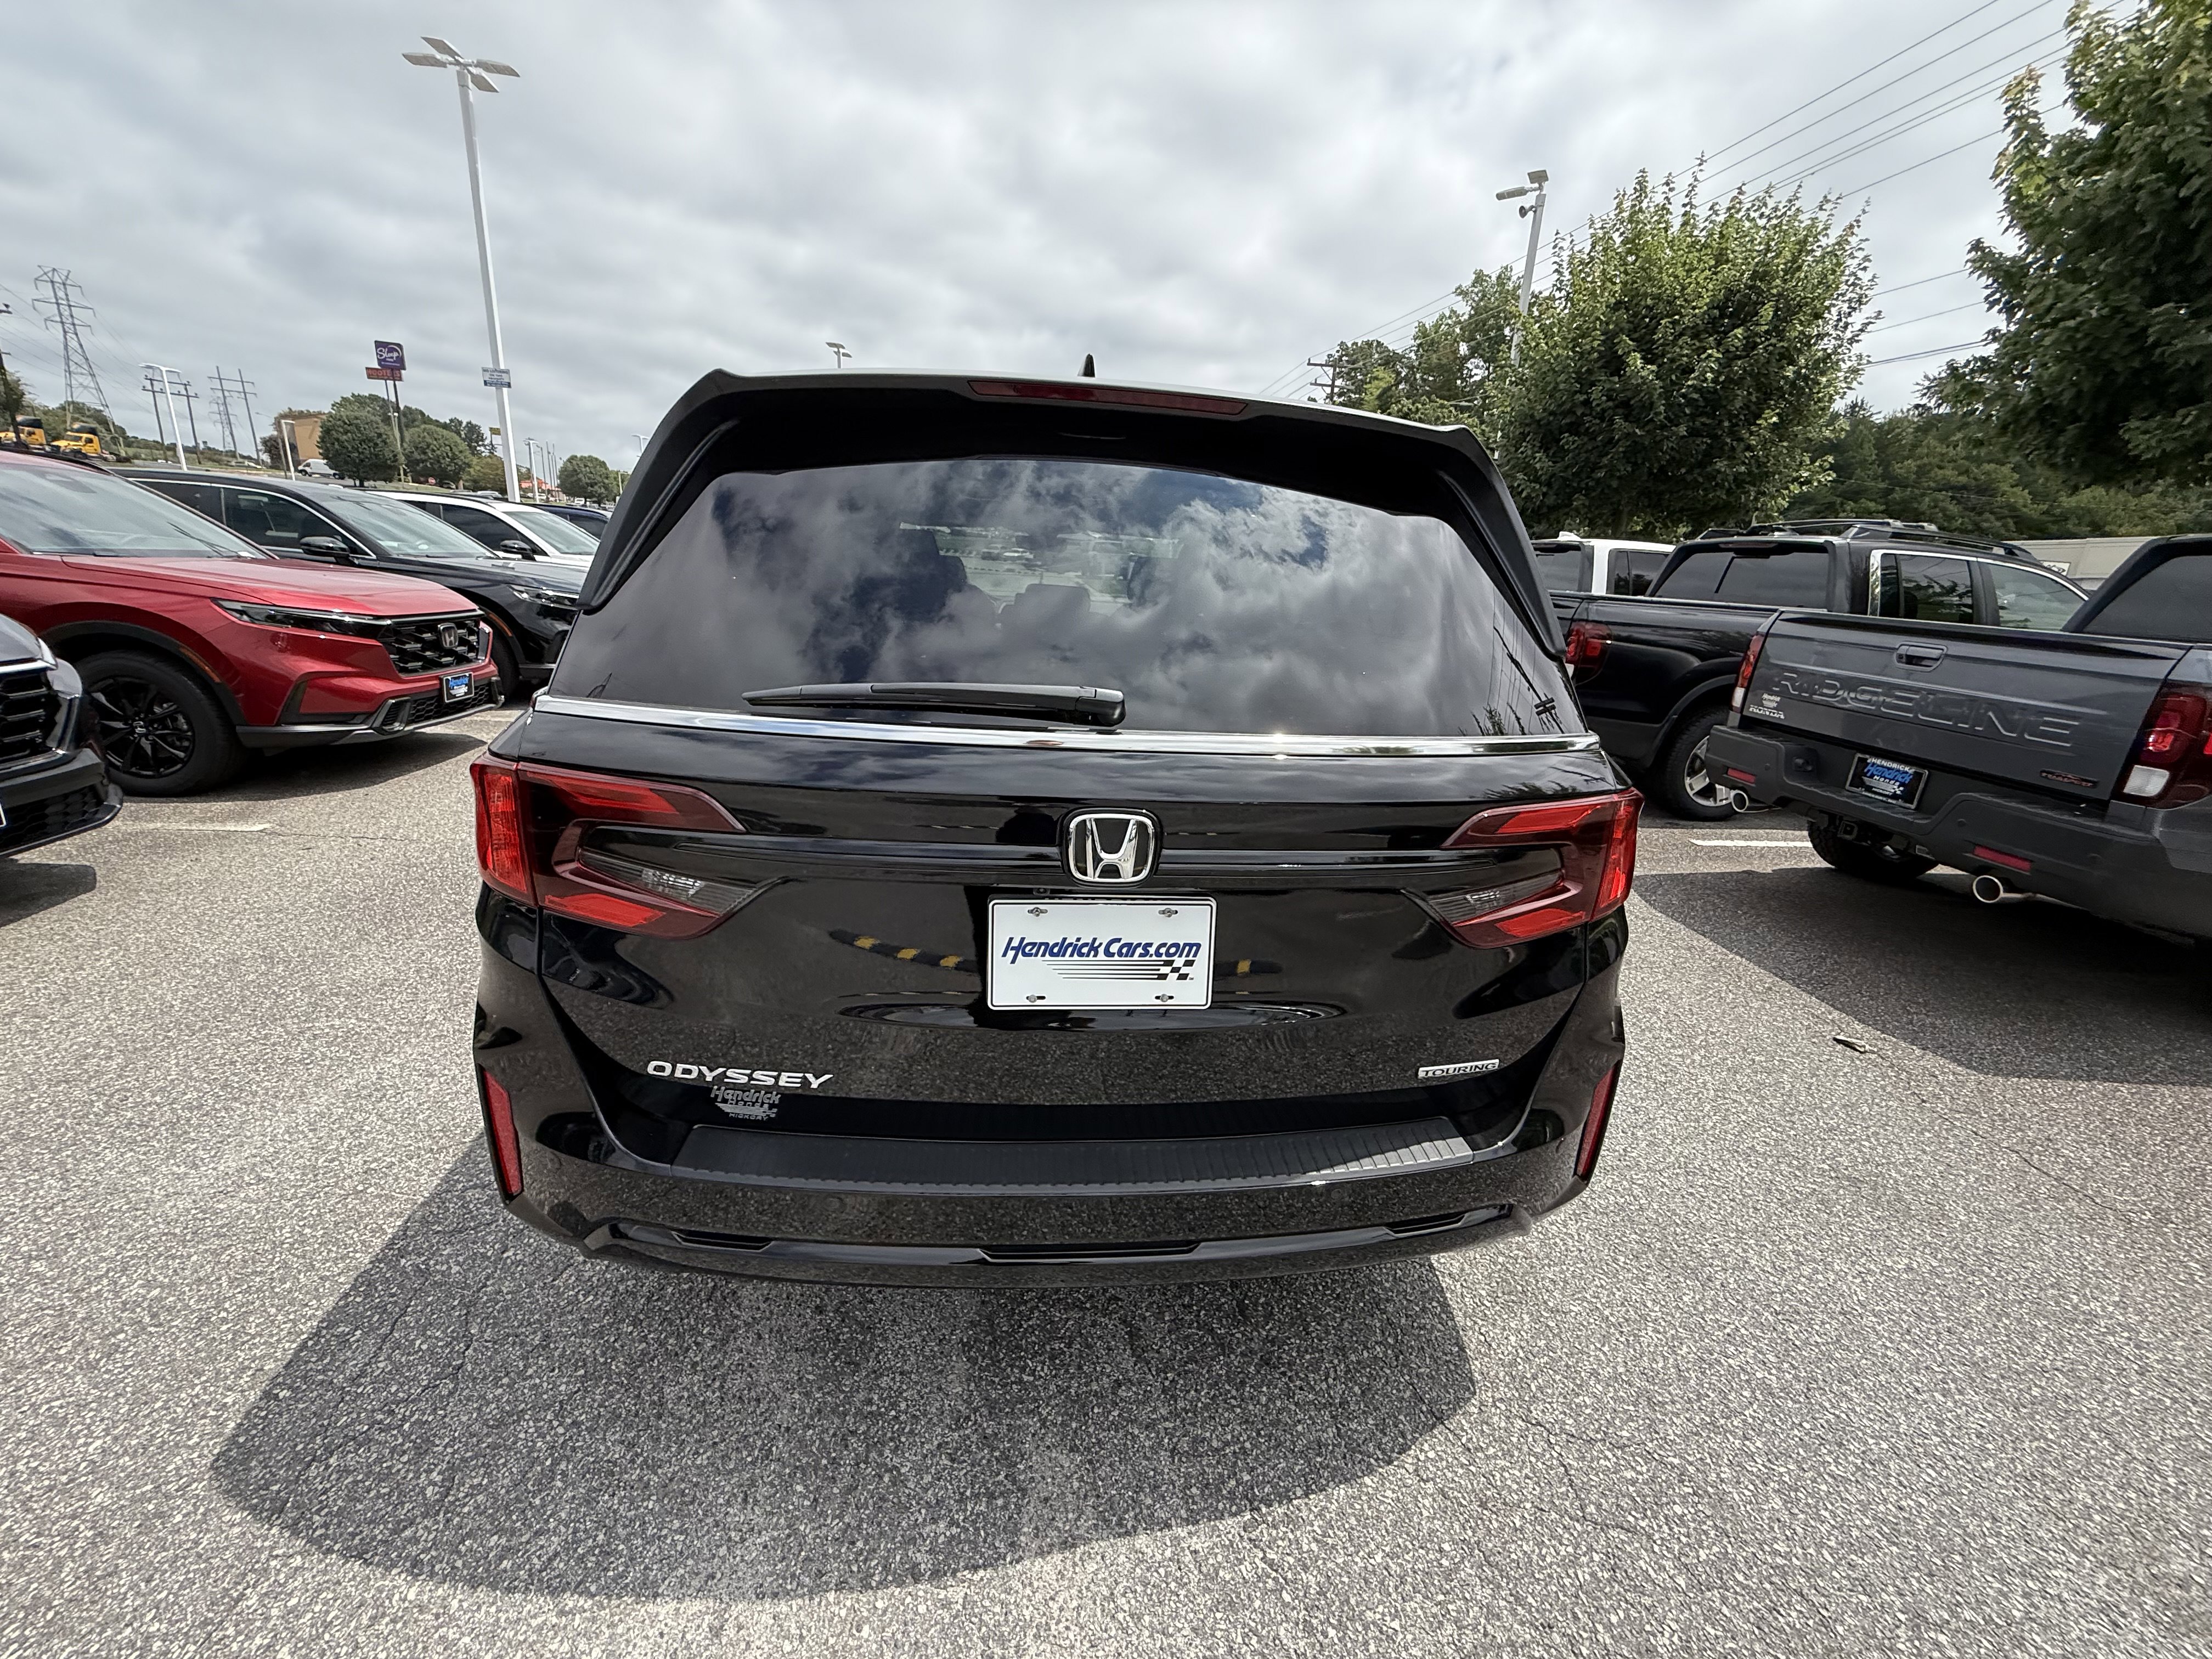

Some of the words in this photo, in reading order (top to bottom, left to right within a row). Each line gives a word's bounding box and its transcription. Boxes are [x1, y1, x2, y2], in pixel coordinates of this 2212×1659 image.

[377, 347, 399, 360] Sleep
[366, 369, 401, 377] HOOTES
[1772, 672, 2080, 747] RIDGELINE
[1871, 758, 1910, 771] HENDRICK
[1864, 762, 1913, 784] Hendrick
[647, 1060, 834, 1089] ODYSSEY
[1423, 1063, 1497, 1077] TOURING
[710, 1086, 781, 1104] Hendrick
[727, 1098, 769, 1108] Honda
[729, 1113, 769, 1121] HICKORY
